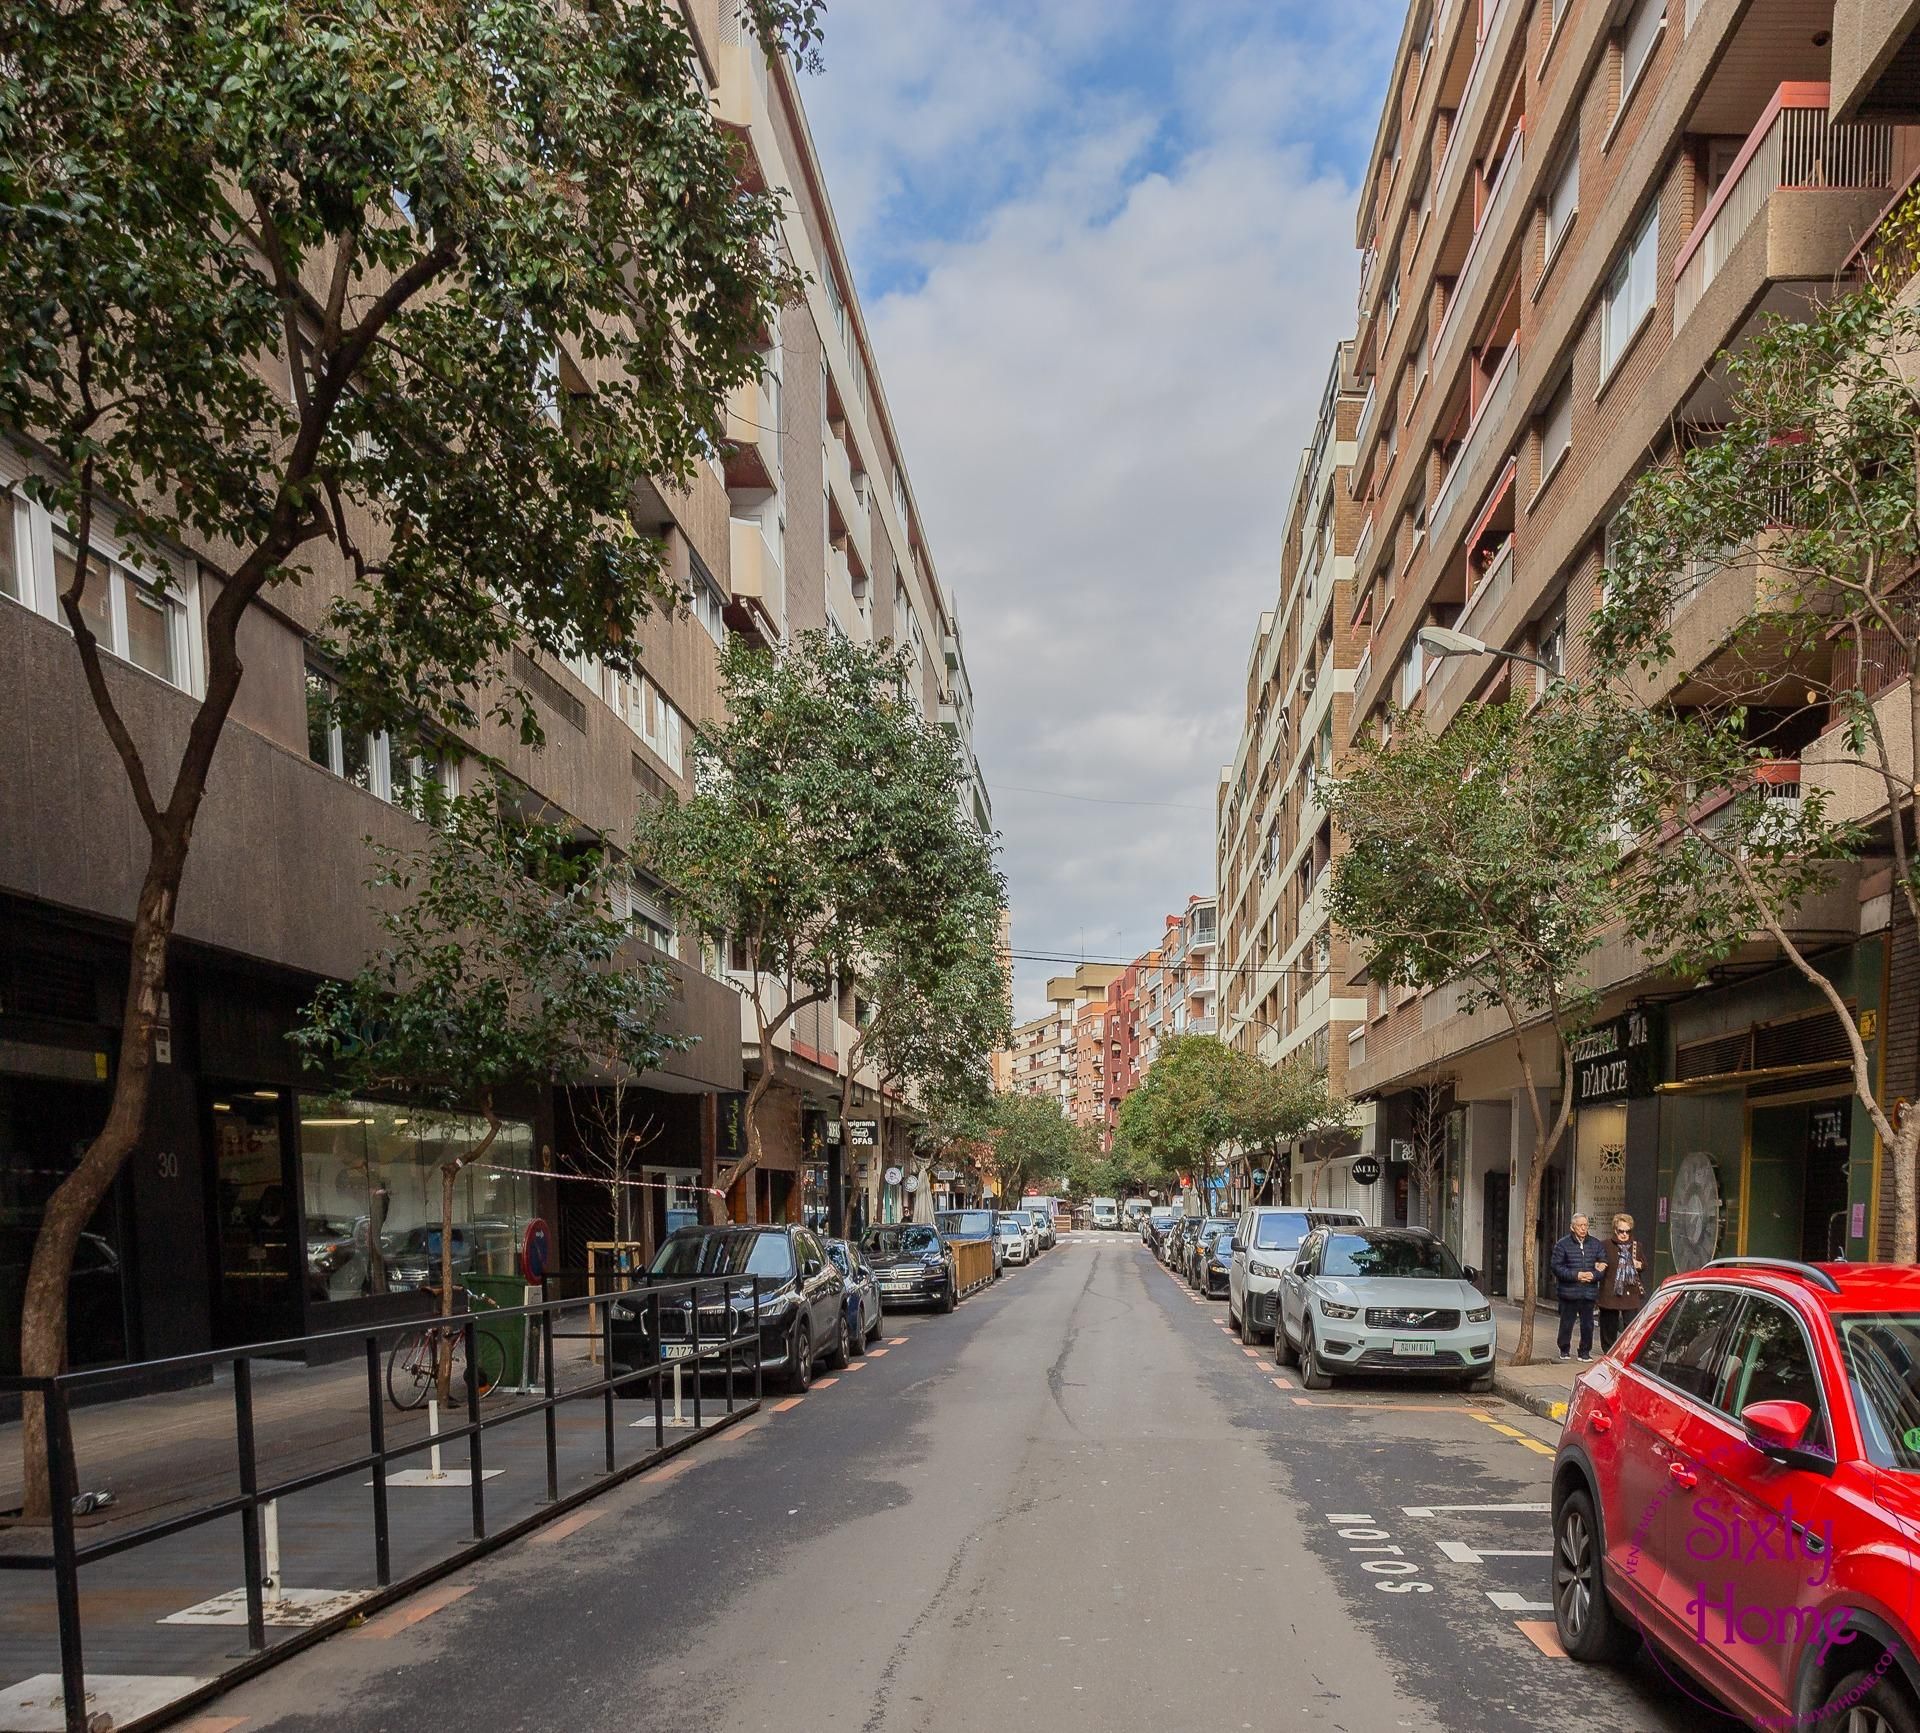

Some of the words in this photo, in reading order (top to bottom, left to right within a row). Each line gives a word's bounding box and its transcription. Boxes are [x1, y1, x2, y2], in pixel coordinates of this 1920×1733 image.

[1581, 1060, 1628, 1098] D'ARTE
[847, 1119, 876, 1128] pigrama
[852, 1137, 873, 1145] OFAS
[158, 1151, 178, 1178] 30
[1593, 1174, 1624, 1184] D'ART
[1325, 1513, 1434, 1593] MOTOS
